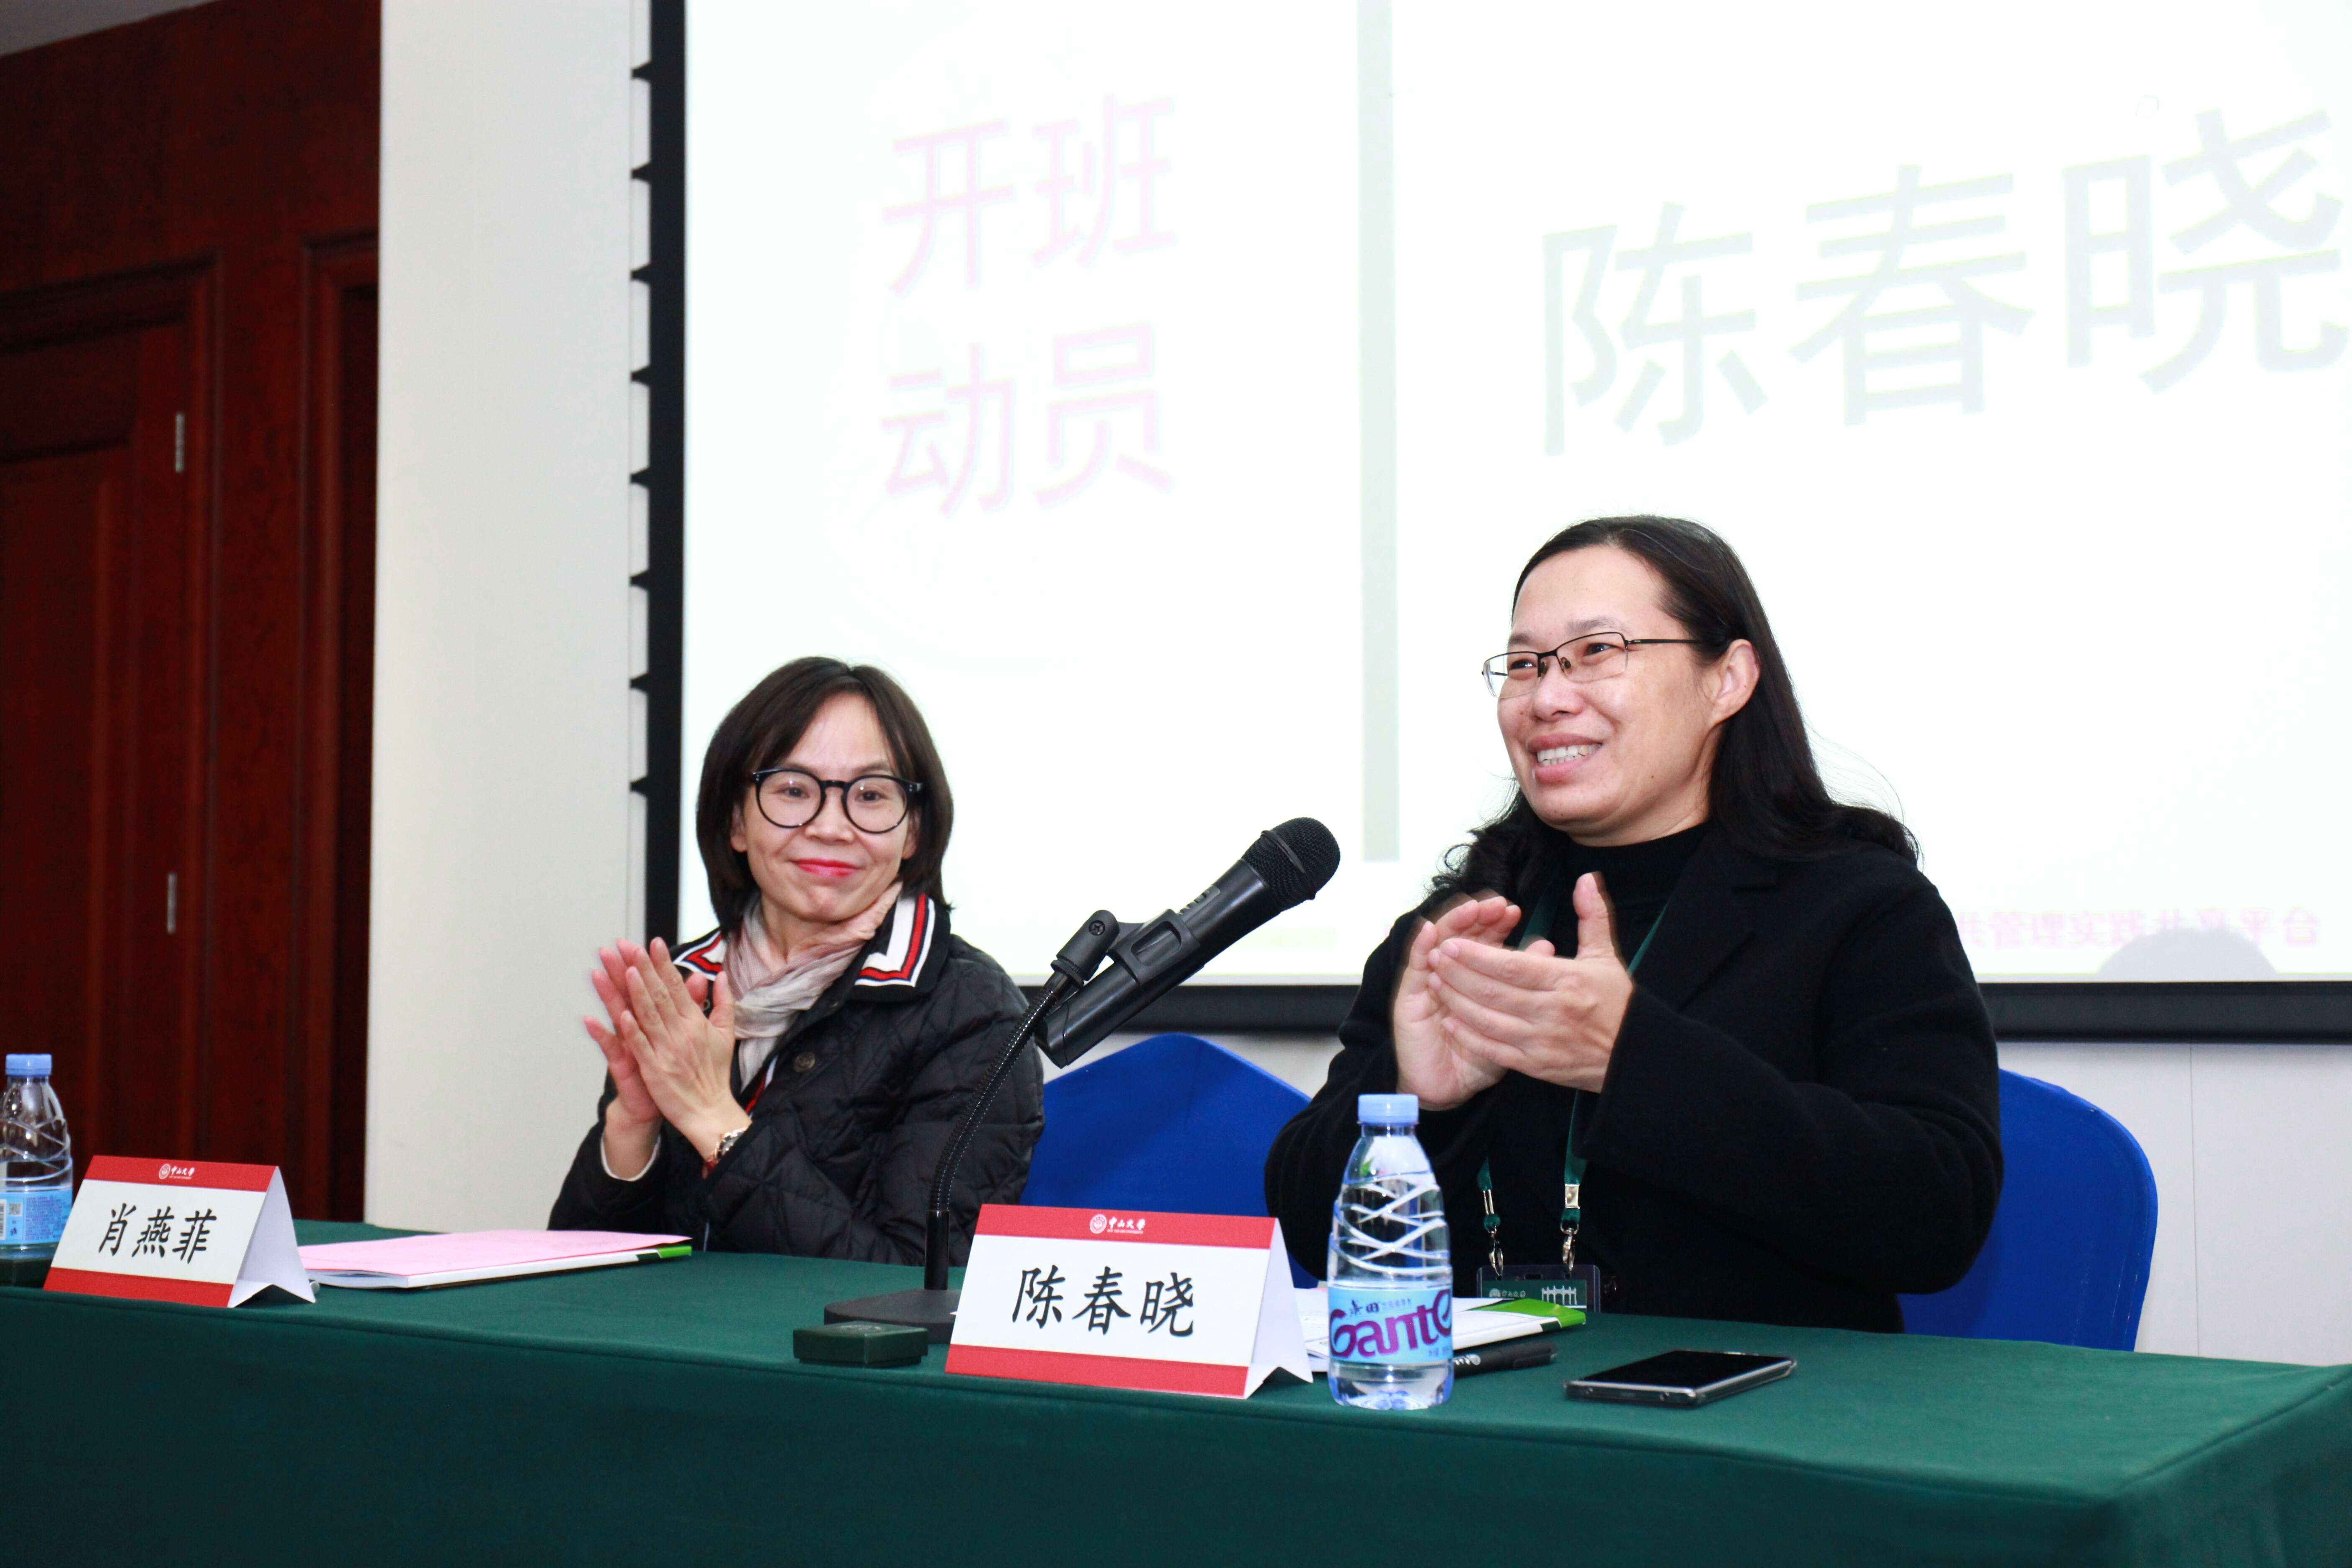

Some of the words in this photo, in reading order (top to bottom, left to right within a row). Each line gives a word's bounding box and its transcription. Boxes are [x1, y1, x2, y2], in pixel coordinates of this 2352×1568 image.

[882, 93, 1179, 297] 开班
[1543, 109, 2350, 456] 陈春晓
[880, 322, 1176, 519] 动员
[99, 1203, 217, 1263] 肖燕菲
[1012, 1265, 1193, 1336] 陈春晓
